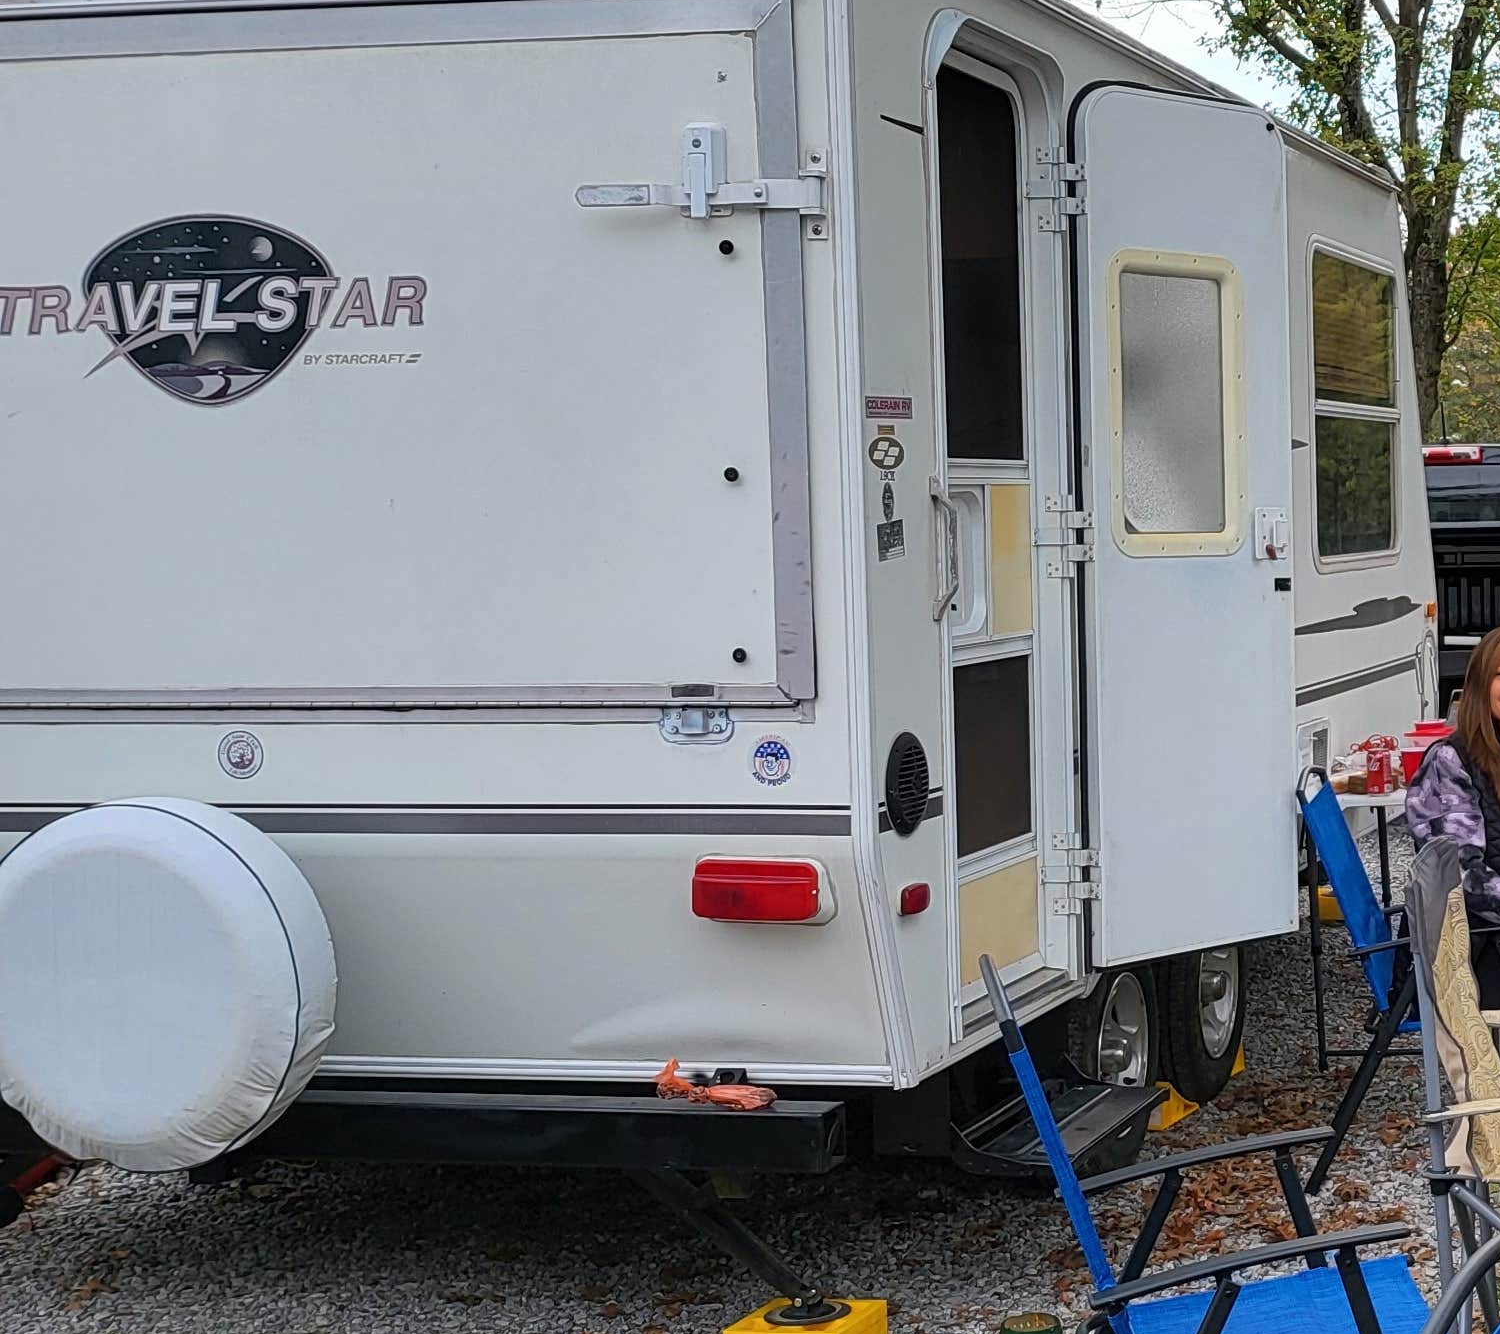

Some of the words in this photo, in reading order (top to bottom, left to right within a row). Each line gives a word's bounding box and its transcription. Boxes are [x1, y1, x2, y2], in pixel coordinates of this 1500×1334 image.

[0, 279, 237, 335] TRAVEL
[255, 275, 428, 331] STAR
[303, 354, 321, 365] BY
[324, 353, 405, 365] STARCRAFT
[867, 399, 901, 410] COLERAIN
[902, 401, 911, 411] RV
